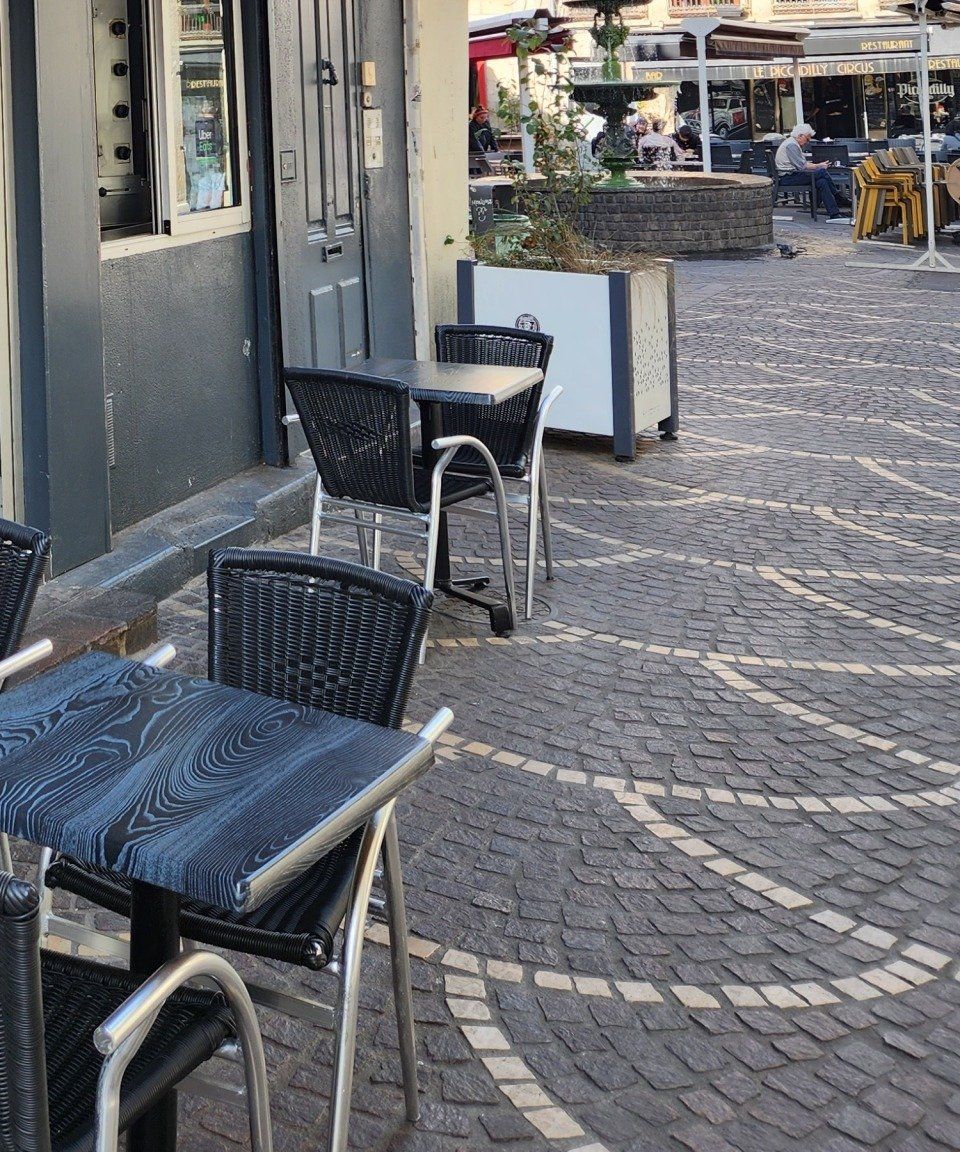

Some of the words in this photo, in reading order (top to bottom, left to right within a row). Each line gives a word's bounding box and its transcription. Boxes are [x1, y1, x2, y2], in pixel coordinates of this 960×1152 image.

[860, 39, 914, 51] RESTAURANT
[753, 66, 764, 78] LE
[770, 63, 828, 78] PICCDILLY
[837, 61, 875, 74] CIRCUS
[198, 129, 212, 140] Uber
